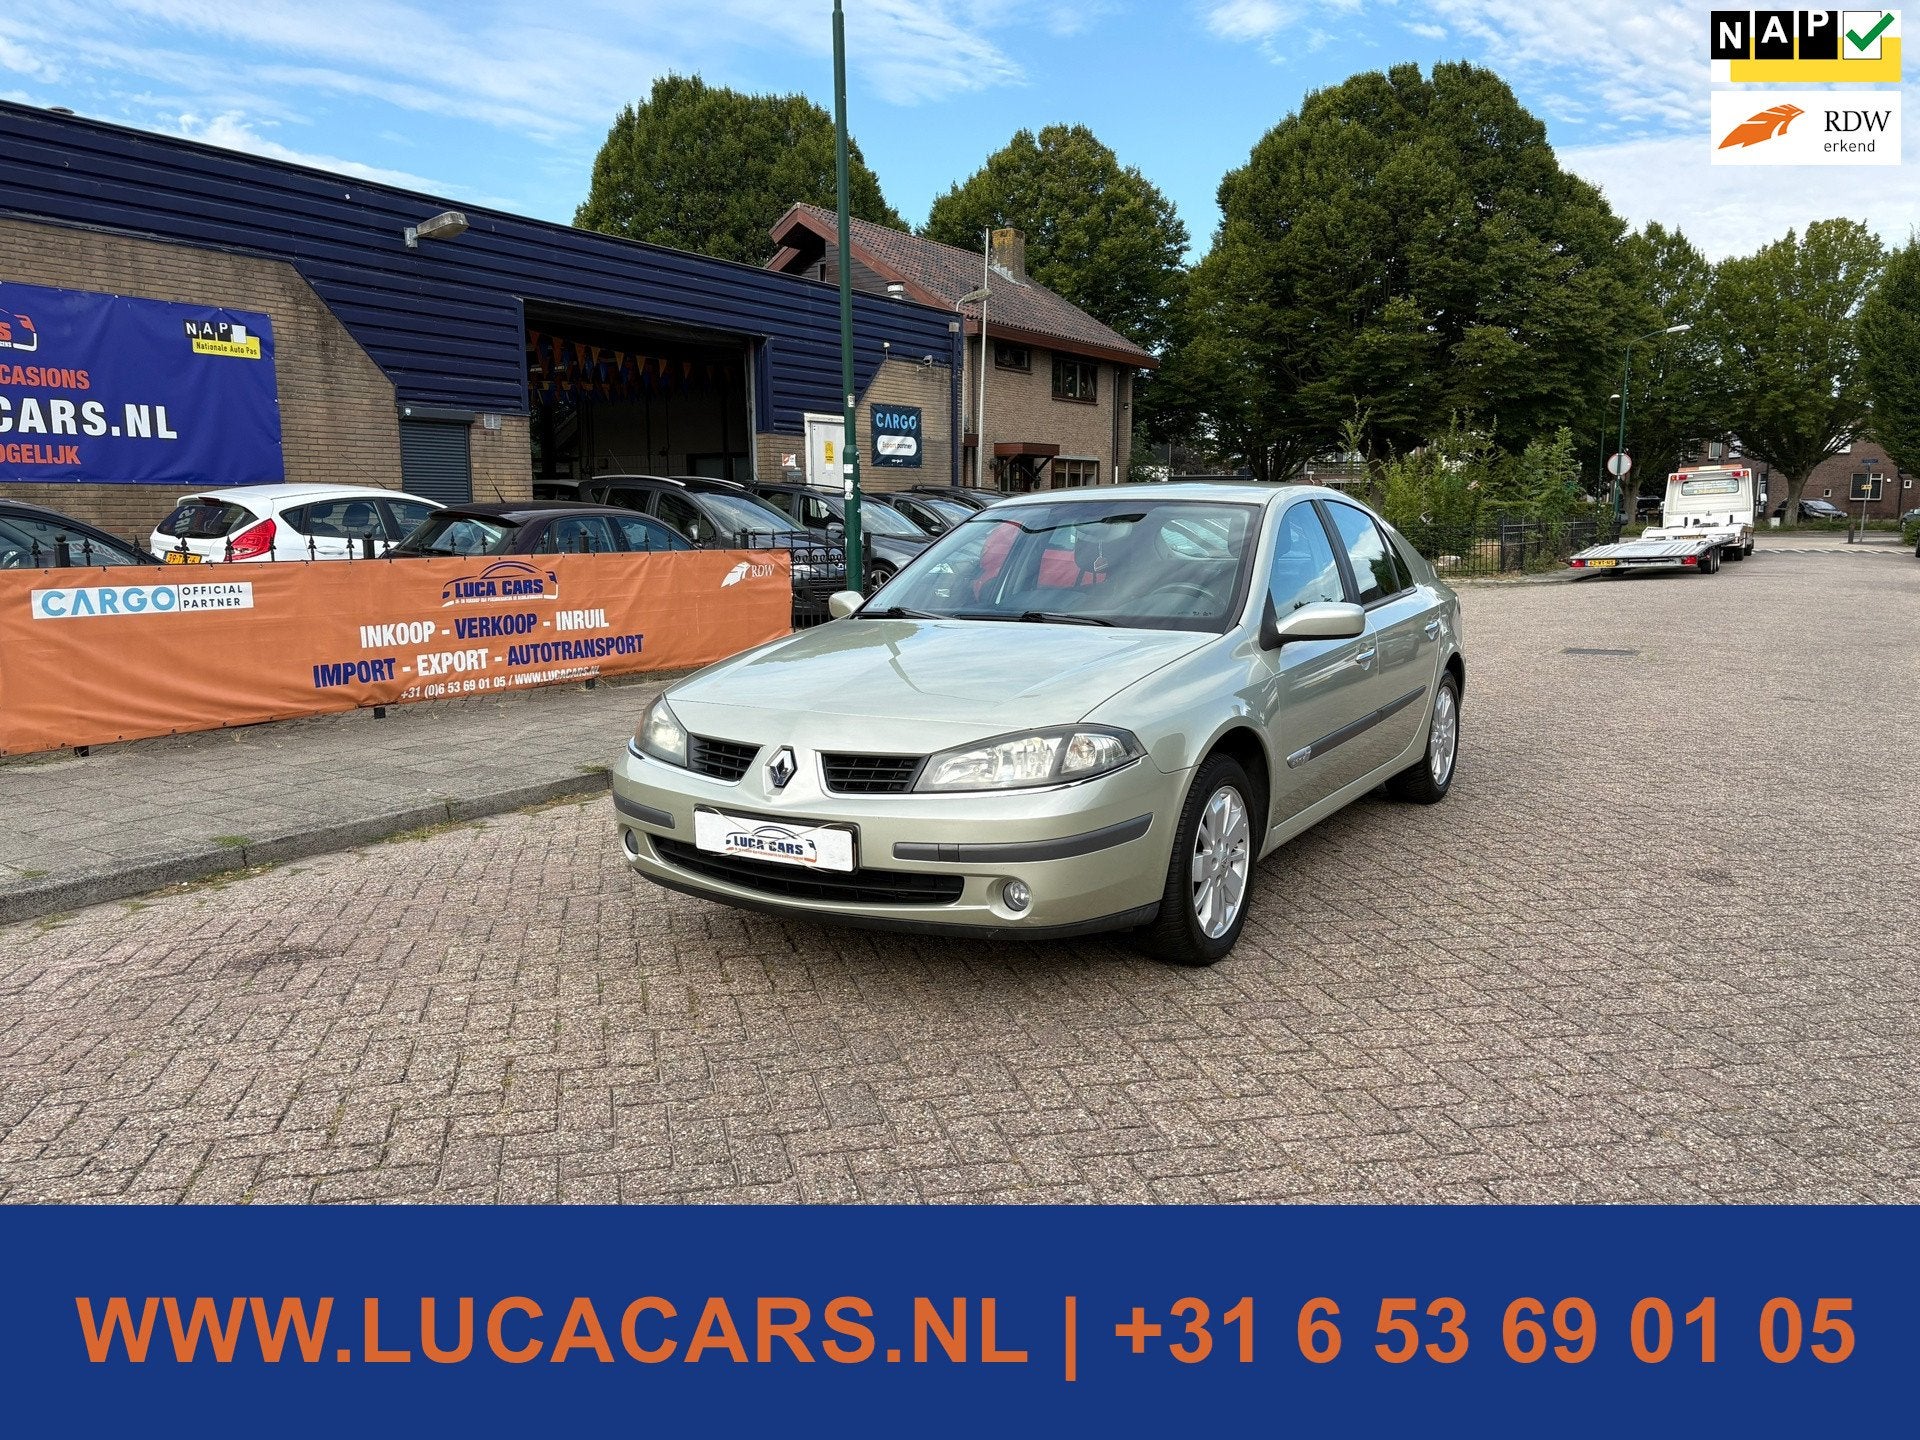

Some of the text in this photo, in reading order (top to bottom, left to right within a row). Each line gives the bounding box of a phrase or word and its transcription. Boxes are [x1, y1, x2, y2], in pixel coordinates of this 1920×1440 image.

[185, 322, 228, 335] NAP
[195, 341, 257, 355] Nationale Auto Pas
[876, 412, 917, 430] CARGO
[751, 564, 775, 578] RDW
[455, 581, 497, 599] LUCA
[501, 578, 544, 595] CARS
[41, 584, 243, 617] CARGO OFFICIAL
[183, 597, 241, 609] PARTNER
[359, 620, 436, 649] INKOOP
[454, 612, 538, 640] VERKOOP
[555, 608, 610, 631] INRUIL
[313, 657, 396, 688] IMPORT
[416, 647, 489, 677] EXPORT
[507, 634, 644, 666] AUTOTRANSPORT
[401, 686, 421, 700] +31
[424, 682, 445, 699] (0)6
[448, 679, 461, 693] 53
[463, 679, 476, 691] 69
[478, 678, 490, 689] 01
[493, 675, 506, 687] 05
[733, 835, 765, 851] LUCA
[768, 840, 804, 856] CARS
